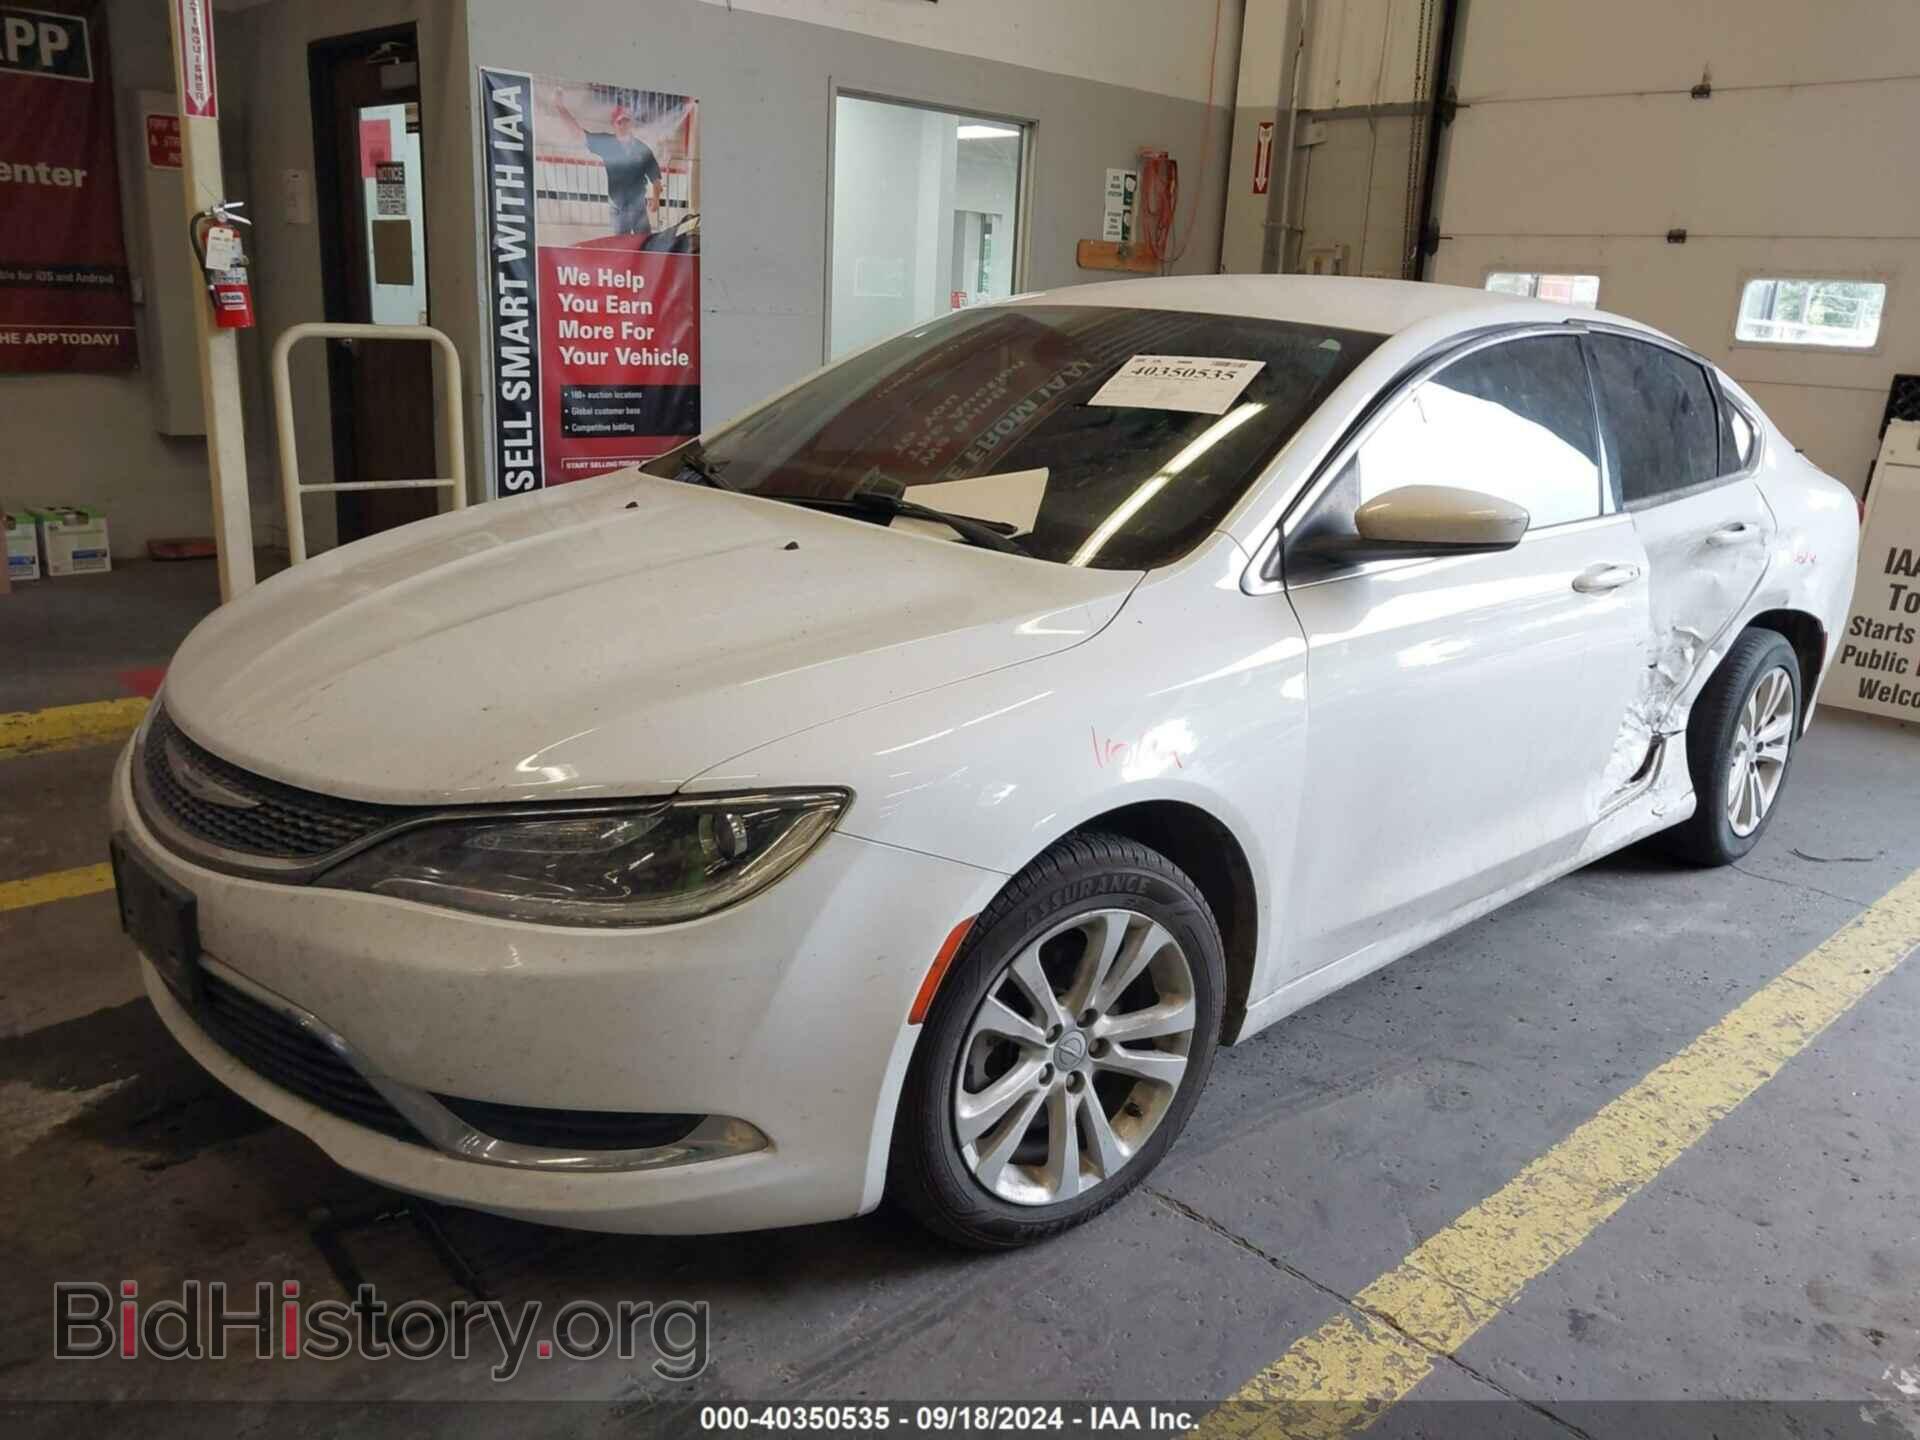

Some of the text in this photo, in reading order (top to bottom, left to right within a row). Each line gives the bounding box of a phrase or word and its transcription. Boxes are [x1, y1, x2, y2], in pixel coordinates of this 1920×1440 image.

[0, 17, 69, 66] PP
[0, 161, 87, 187] enter
[492, 85, 535, 490] SELL SMART WITH IAA
[557, 266, 645, 293] We Help
[558, 293, 653, 315] You Earn
[24, 333, 58, 345] APP
[60, 333, 119, 346] TODAY!
[559, 320, 655, 340] More For
[559, 346, 689, 366] Your Vehicle
[1131, 366, 1238, 380] 40350535
[588, 391, 613, 399] auction
[571, 407, 640, 415] Global customer base
[571, 423, 635, 433] Competitive bidding
[1849, 616, 1915, 645] Starts
[1840, 644, 1909, 675] Public
